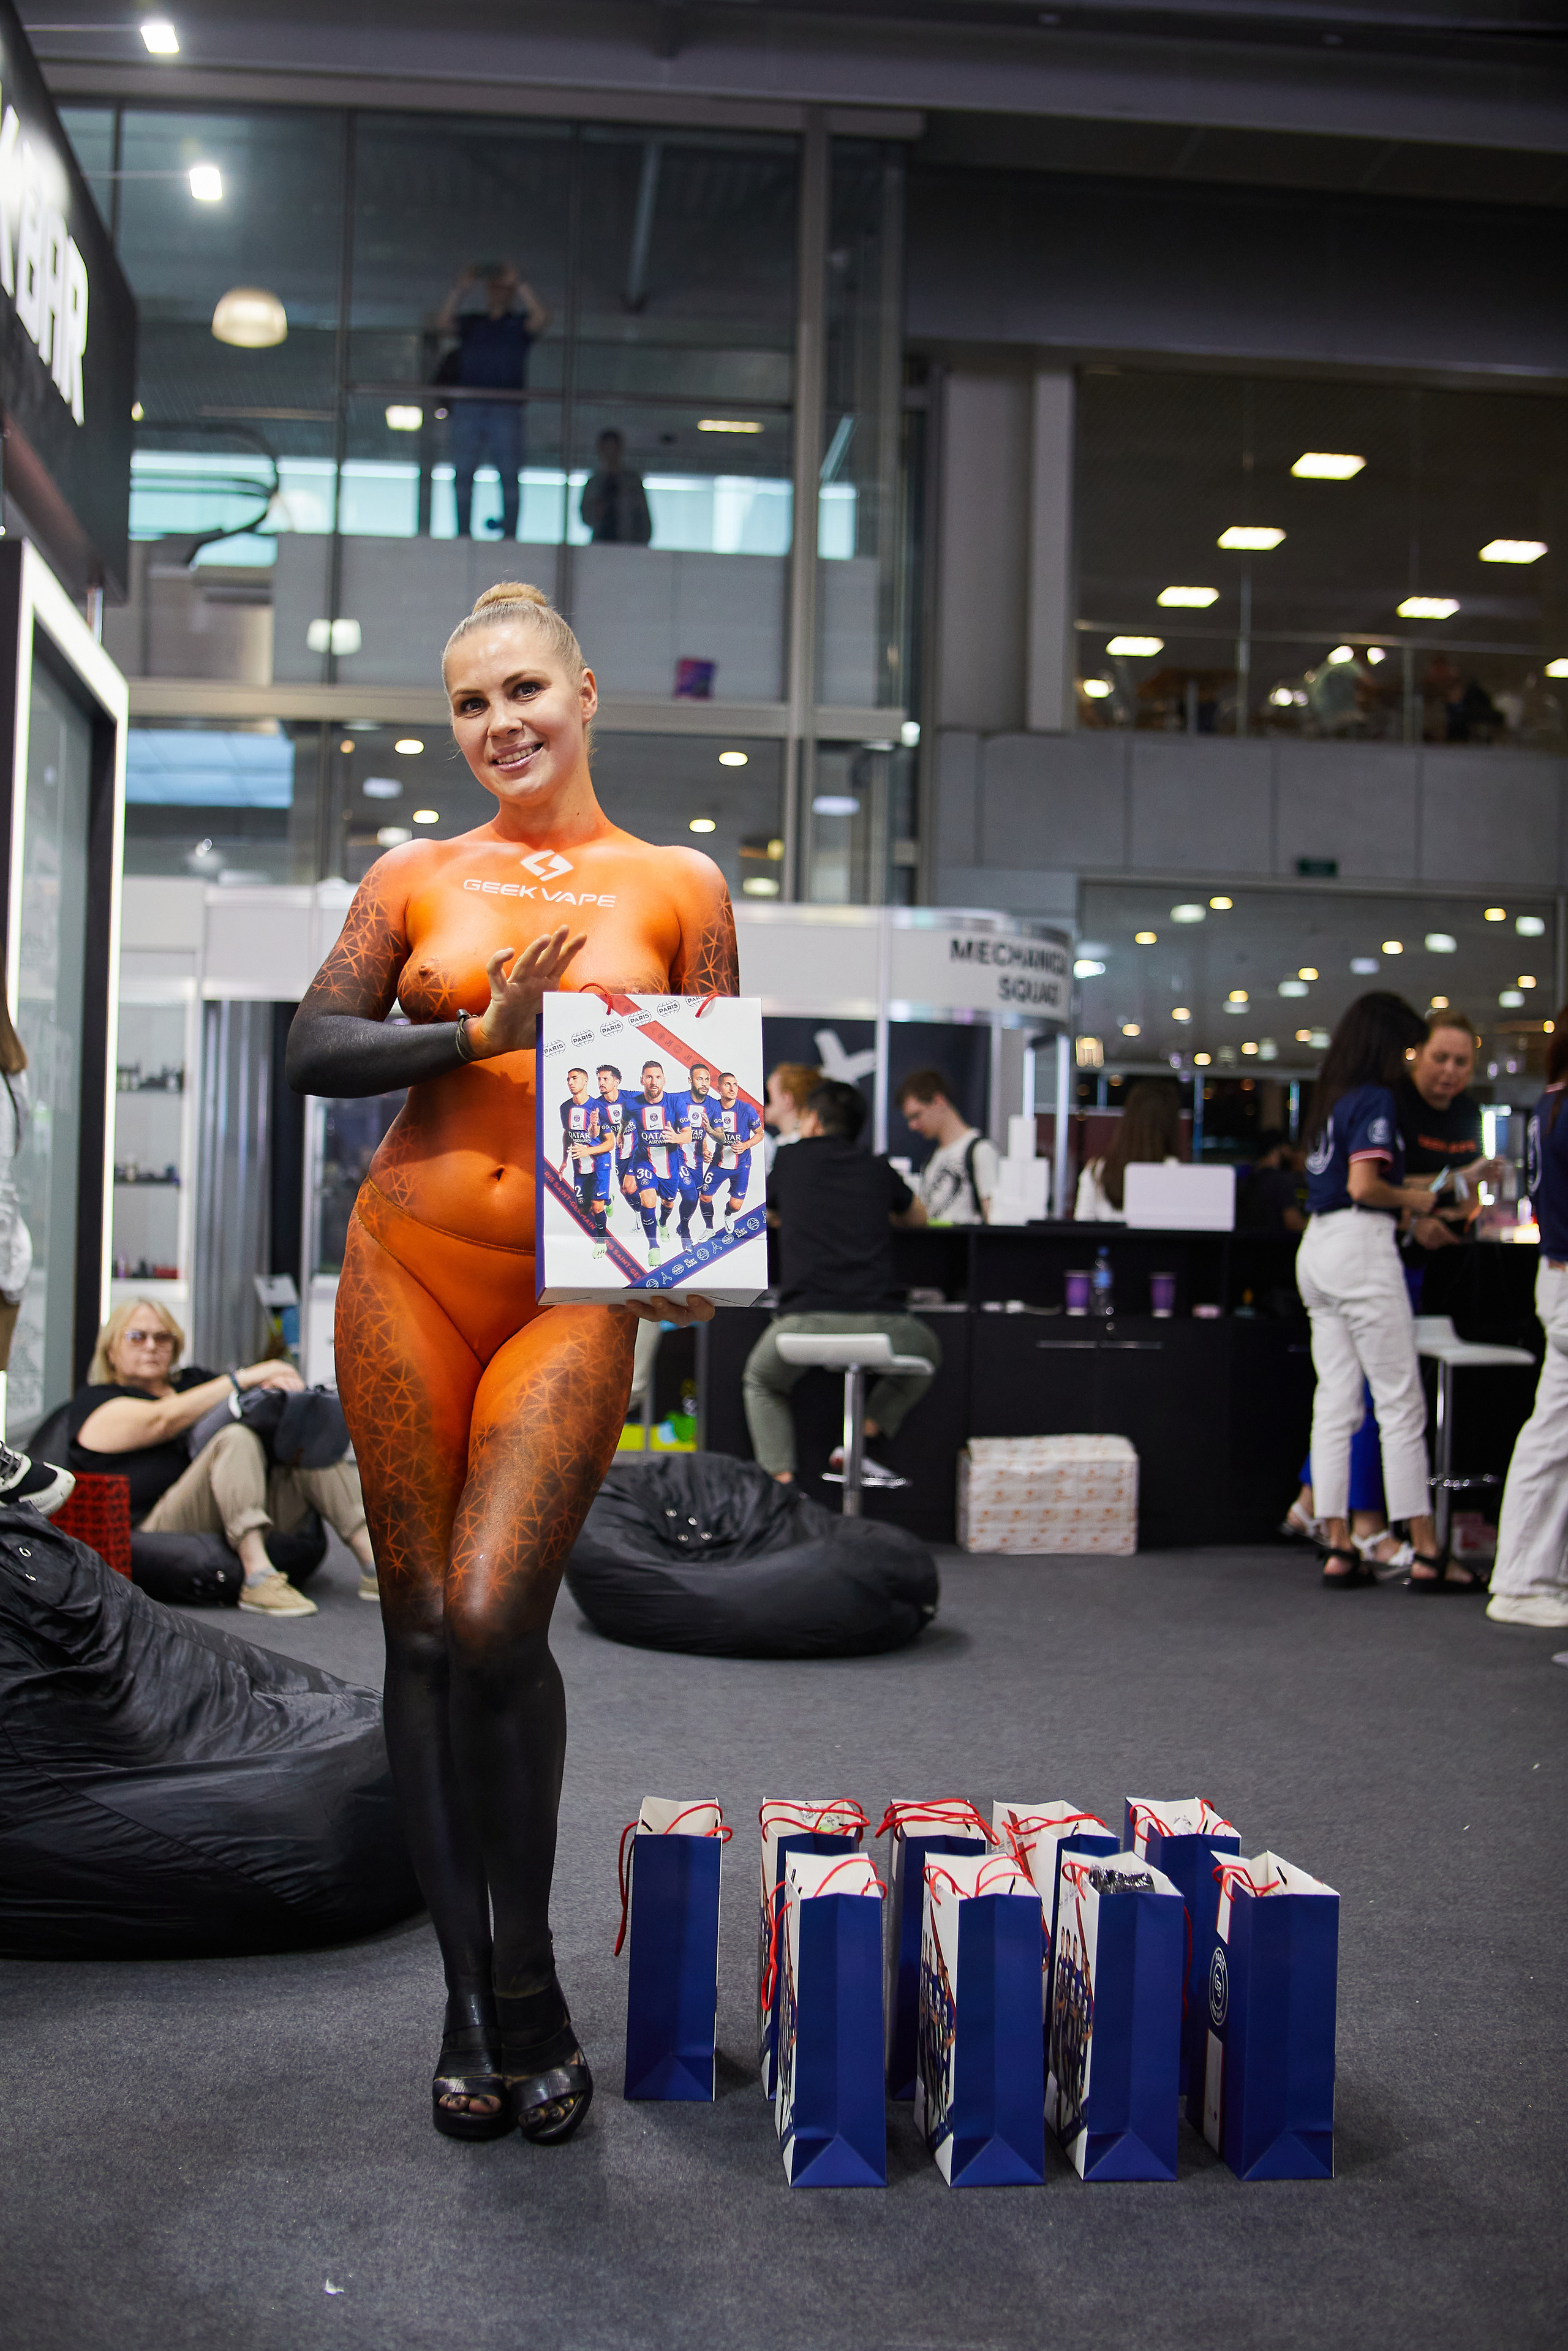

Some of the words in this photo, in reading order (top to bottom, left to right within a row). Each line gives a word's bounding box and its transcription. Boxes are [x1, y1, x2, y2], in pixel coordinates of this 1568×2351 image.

[658, 1003, 679, 1014] PARIS
[630, 1013, 650, 1024] PARIS
[601, 1023, 622, 1033] PARIS
[573, 1033, 593, 1043] PARIS
[544, 1043, 564, 1054] PARIS
[641, 1132, 668, 1141] QATA
[636, 1168, 652, 1180] 30
[679, 1166, 690, 1178] 10
[705, 1172, 714, 1184] 6
[575, 1185, 583, 1198] 2
